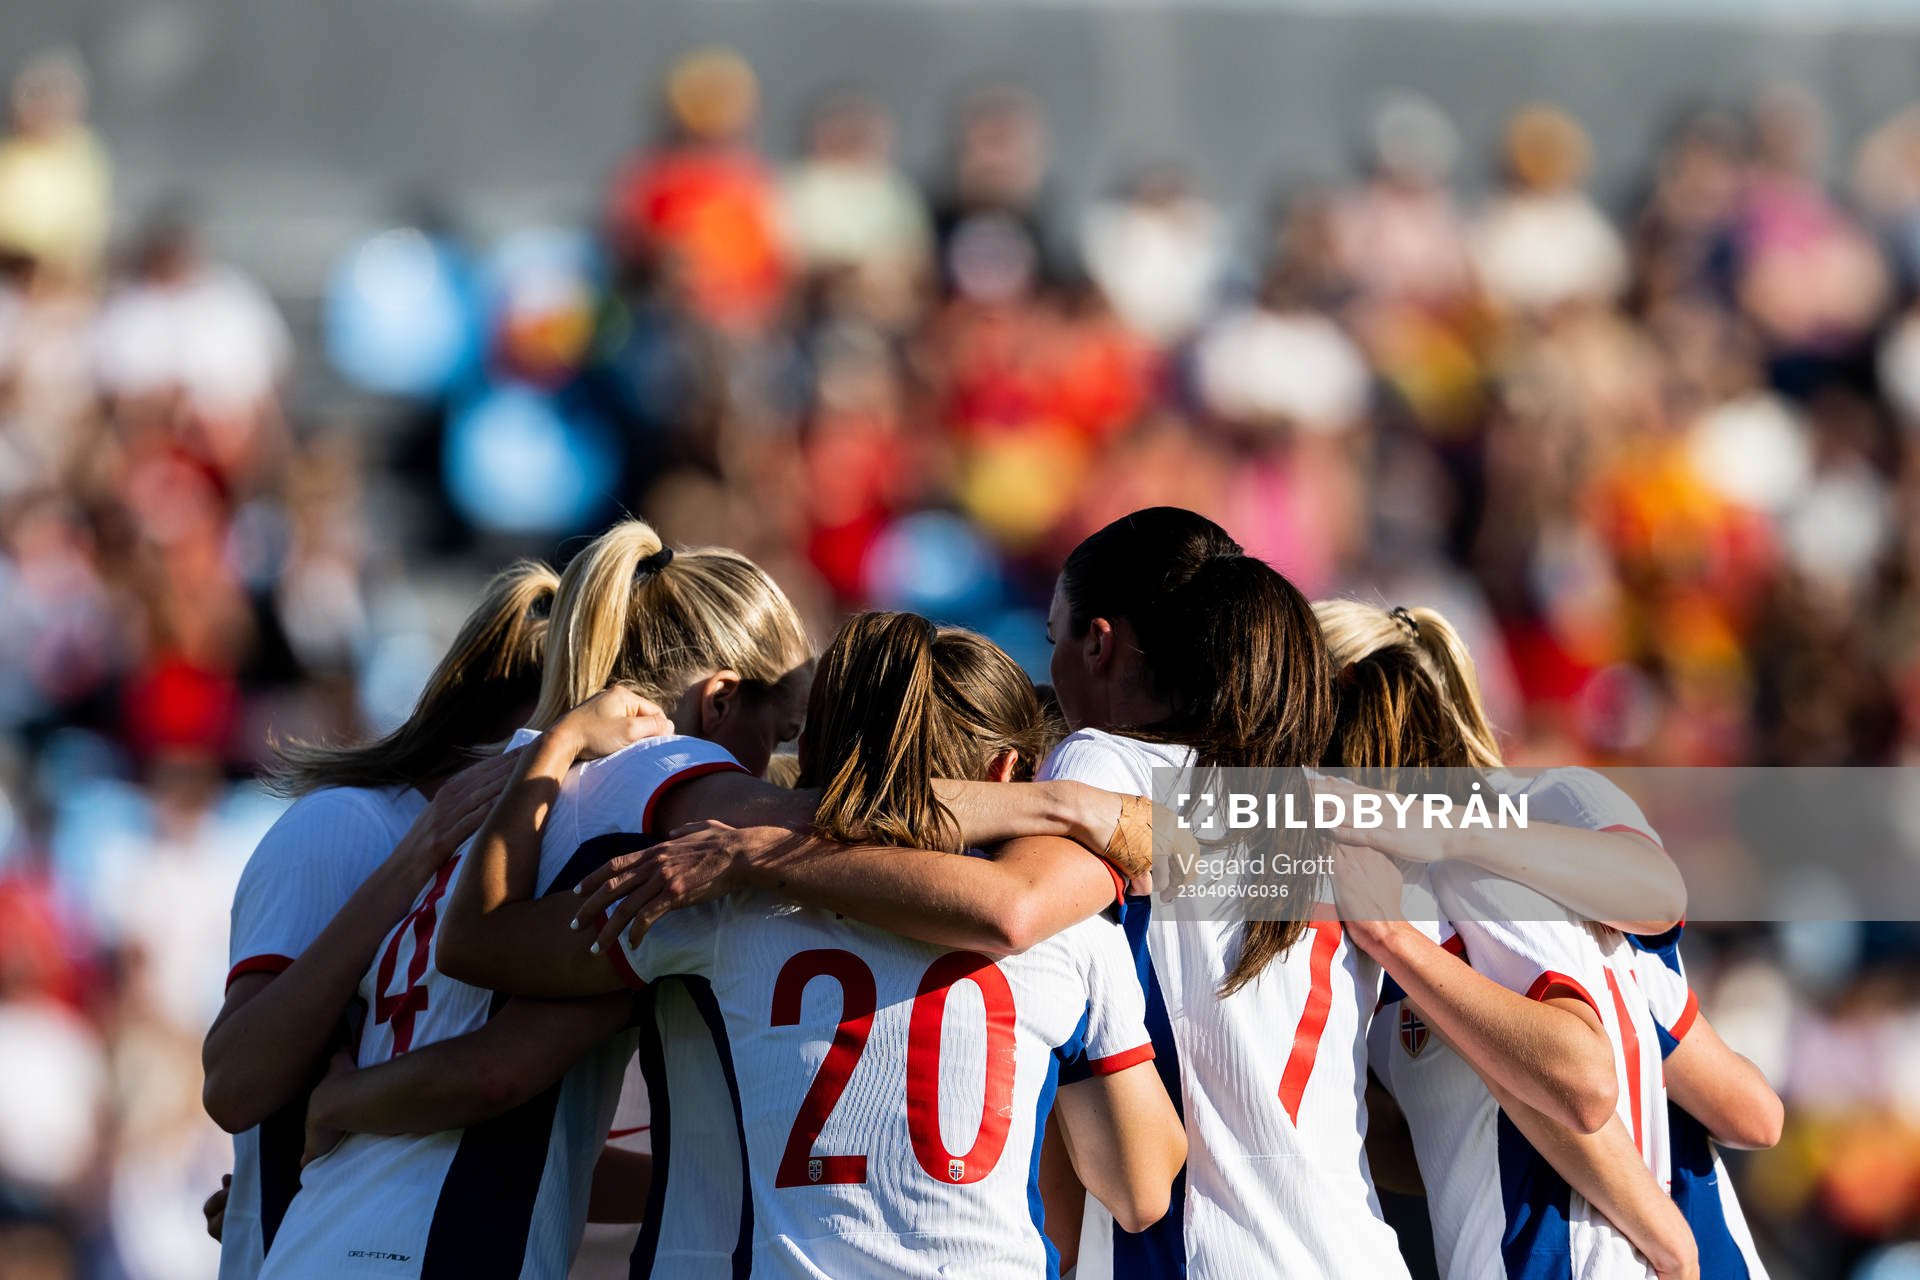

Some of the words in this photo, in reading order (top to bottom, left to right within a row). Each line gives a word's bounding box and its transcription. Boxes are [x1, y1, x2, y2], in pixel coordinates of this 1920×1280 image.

[375, 854, 462, 1058] 4
[770, 948, 1016, 1188] 20
[1278, 902, 1342, 1129] 7
